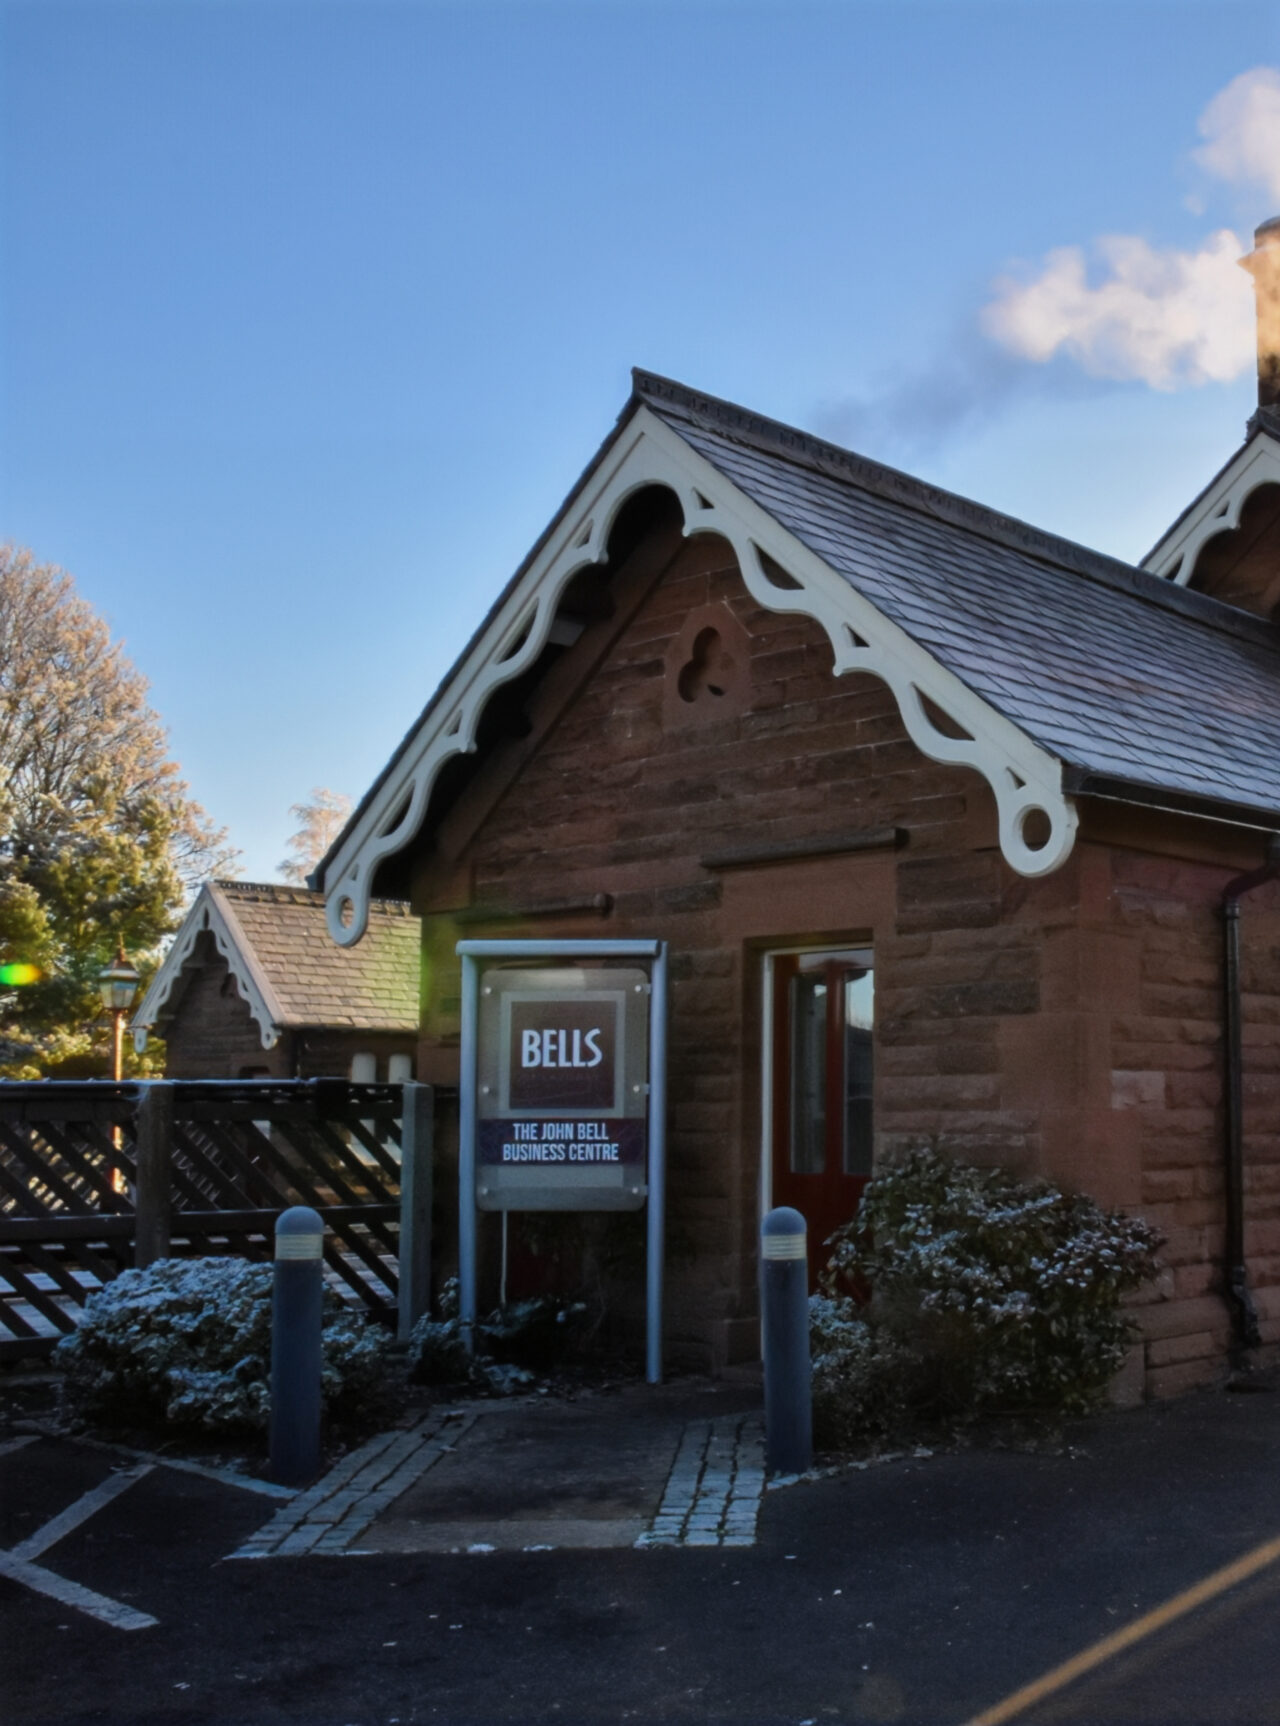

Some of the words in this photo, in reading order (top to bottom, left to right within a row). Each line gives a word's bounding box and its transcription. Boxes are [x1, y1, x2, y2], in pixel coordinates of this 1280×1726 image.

[521, 1028, 602, 1068] BELLS
[512, 1123, 538, 1140] THE
[541, 1123, 574, 1140] JOHN
[577, 1123, 609, 1140] BELL
[503, 1144, 566, 1161] BUSINESS
[569, 1143, 619, 1161] CENTRE
